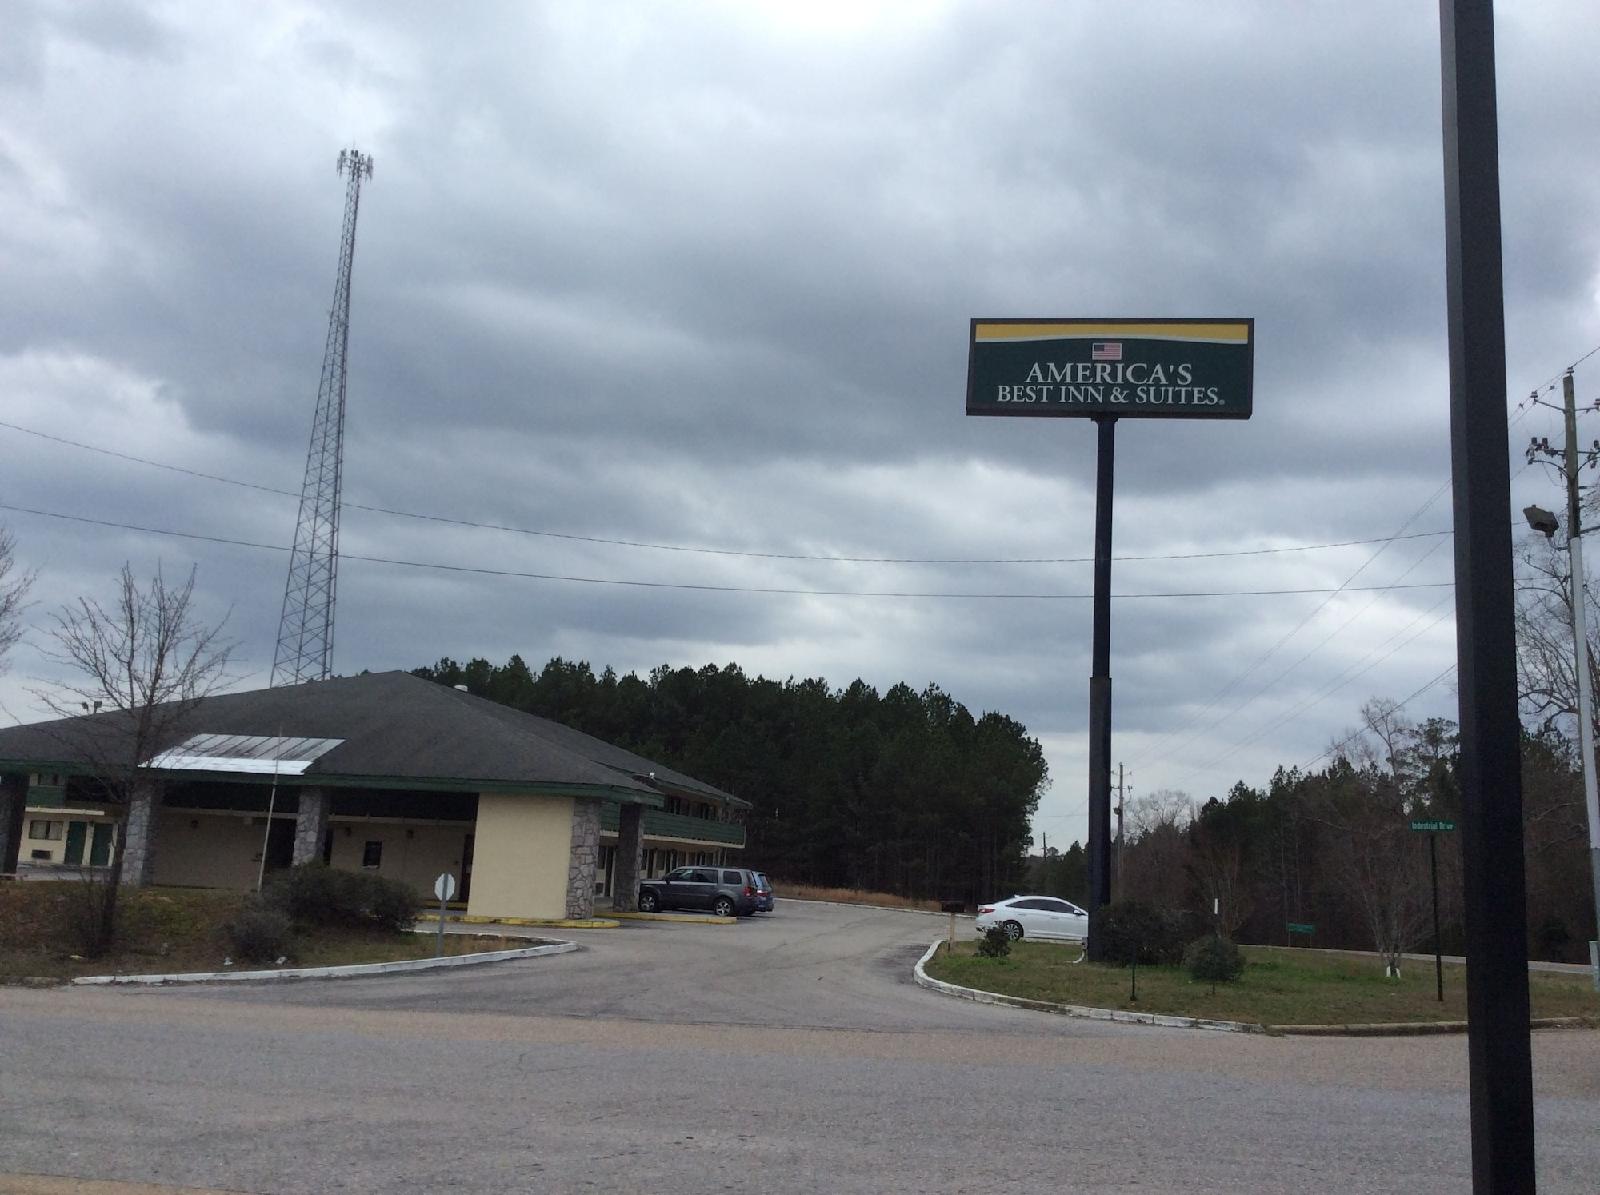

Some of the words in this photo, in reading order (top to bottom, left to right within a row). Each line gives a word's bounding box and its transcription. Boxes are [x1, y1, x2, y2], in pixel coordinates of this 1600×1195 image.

[1025, 362, 1192, 385] AMERICA'S
[997, 386, 1053, 403] BEST
[1060, 386, 1103, 404] INN
[1109, 387, 1129, 404] &
